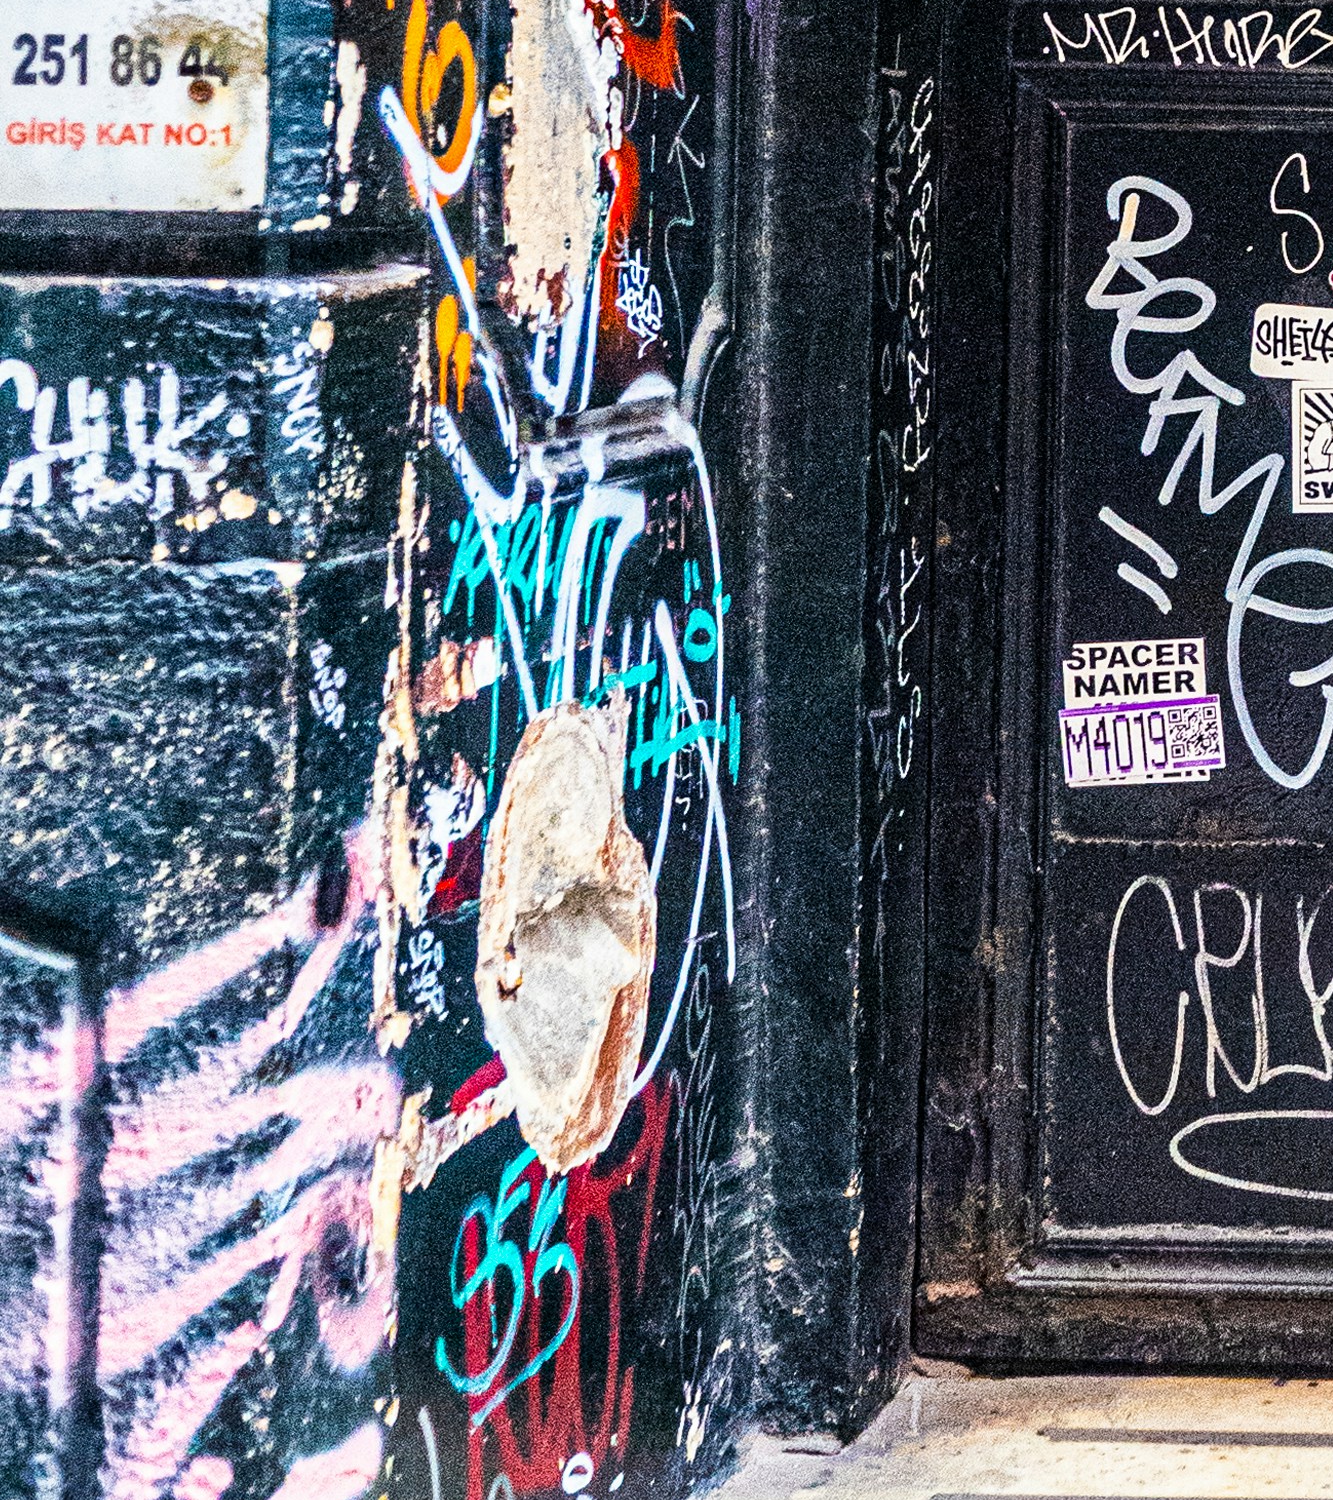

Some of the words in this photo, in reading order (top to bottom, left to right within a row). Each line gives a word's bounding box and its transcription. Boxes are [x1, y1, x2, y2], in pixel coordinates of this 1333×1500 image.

[12, 33, 90, 87] 251
[110, 33, 163, 87] 86
[96, 121, 153, 148] KAT
[163, 120, 234, 148] NO:1
[1066, 642, 1200, 671] SPACER
[1073, 670, 1197, 698] NAMER
[1064, 711, 1169, 779] M4019
